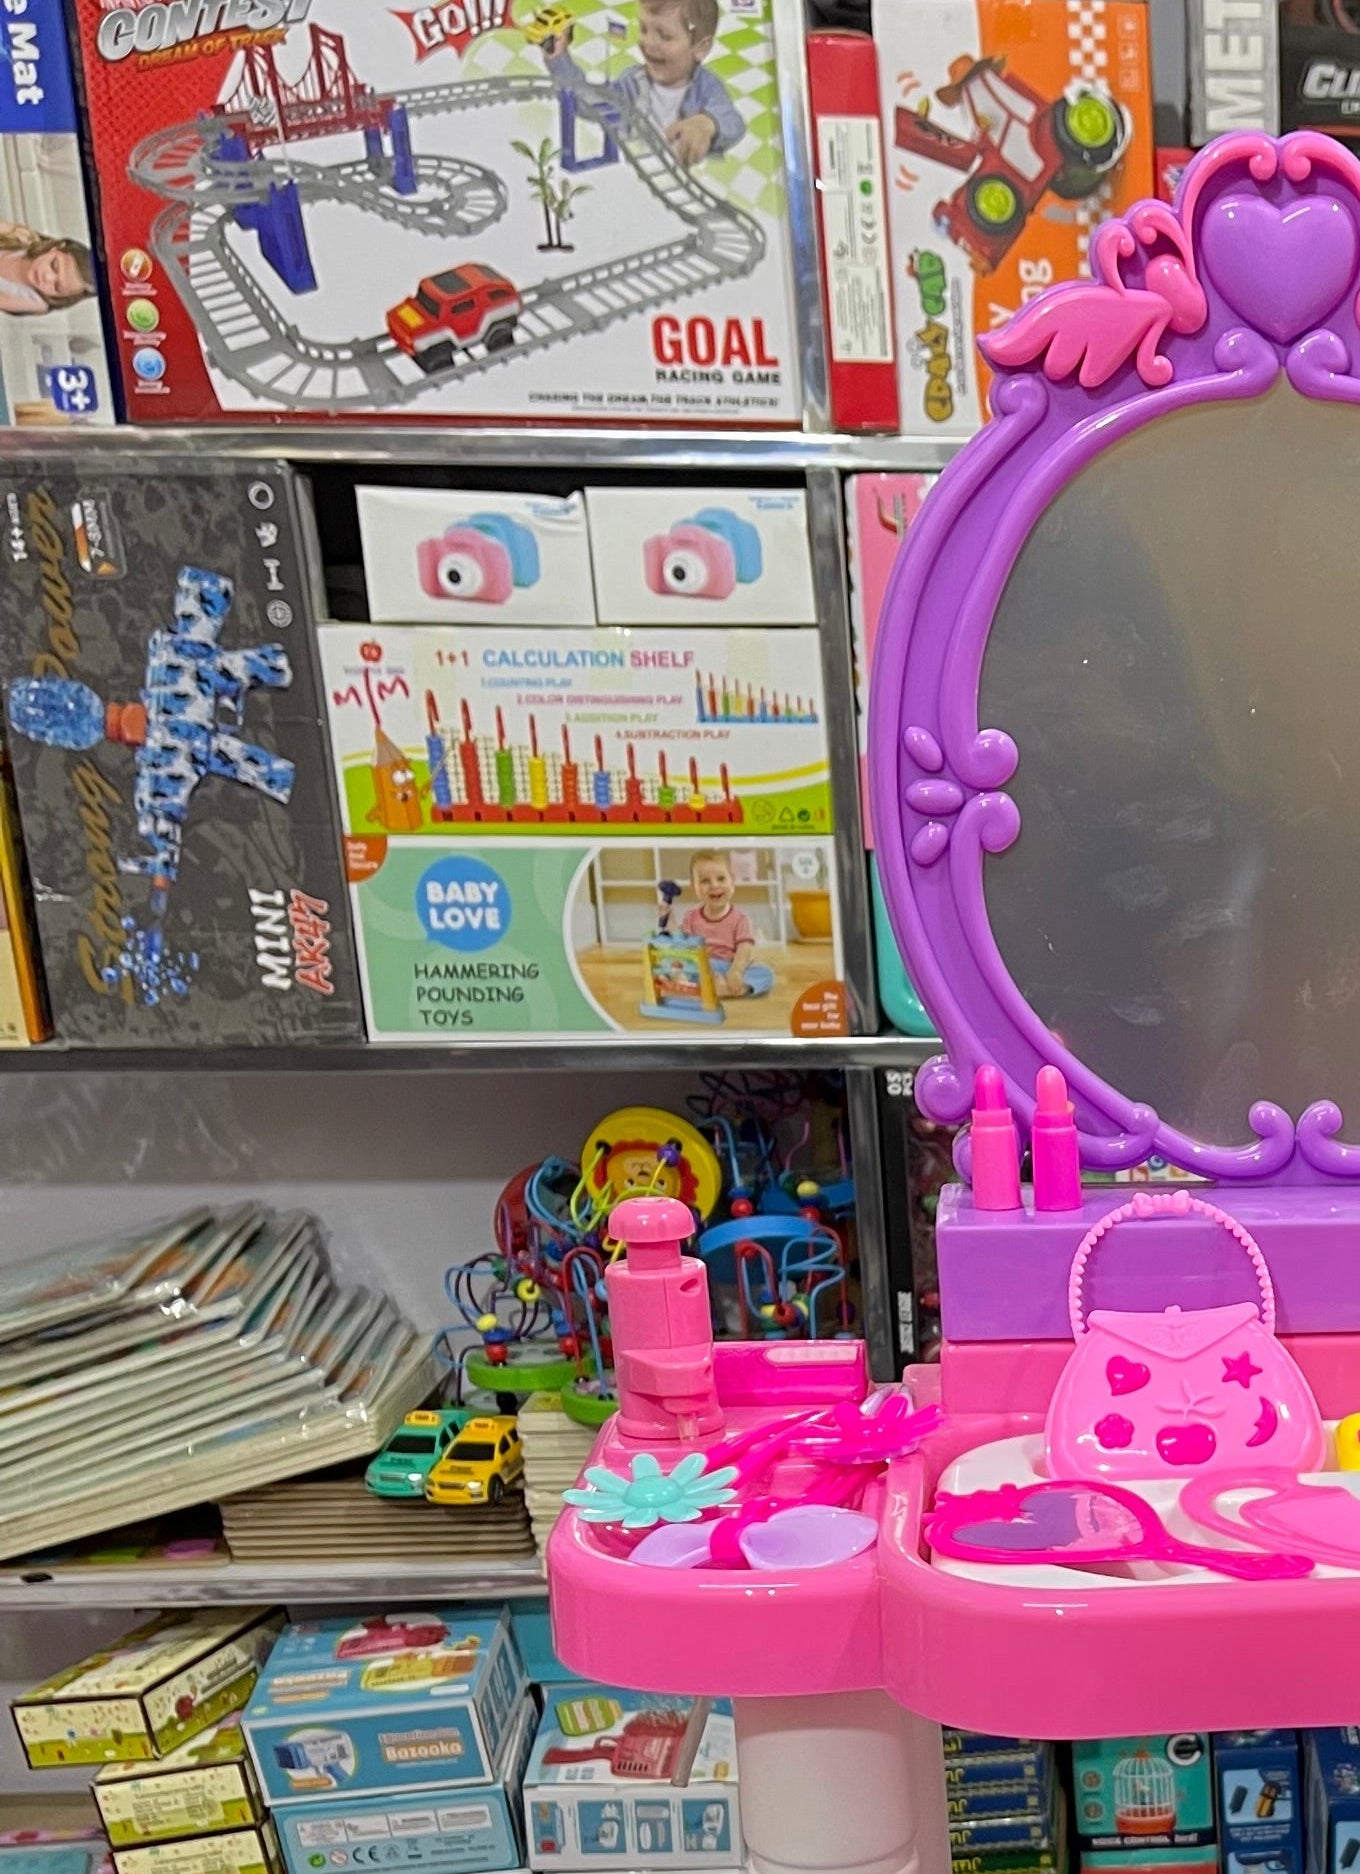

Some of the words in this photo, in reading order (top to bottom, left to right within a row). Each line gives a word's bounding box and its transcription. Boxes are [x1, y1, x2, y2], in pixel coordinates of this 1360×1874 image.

[7, 22, 44, 106] Mat
[653, 314, 779, 367] GOAL
[655, 369, 724, 384] RACING
[732, 370, 781, 386] GAME
[57, 368, 91, 412] 3+
[436, 649, 470, 667] 1+1
[482, 649, 624, 668] CALCULATION
[630, 649, 694, 668] SHELF
[426, 881, 498, 904] BABY
[429, 907, 500, 930] LOVE
[249, 888, 292, 990] MINI
[288, 888, 335, 995] AK47
[415, 962, 539, 980] HAMMERING
[417, 986, 524, 1003] POUNDING
[419, 1008, 473, 1026] TOYS
[385, 1740, 463, 1762] Bazooka
